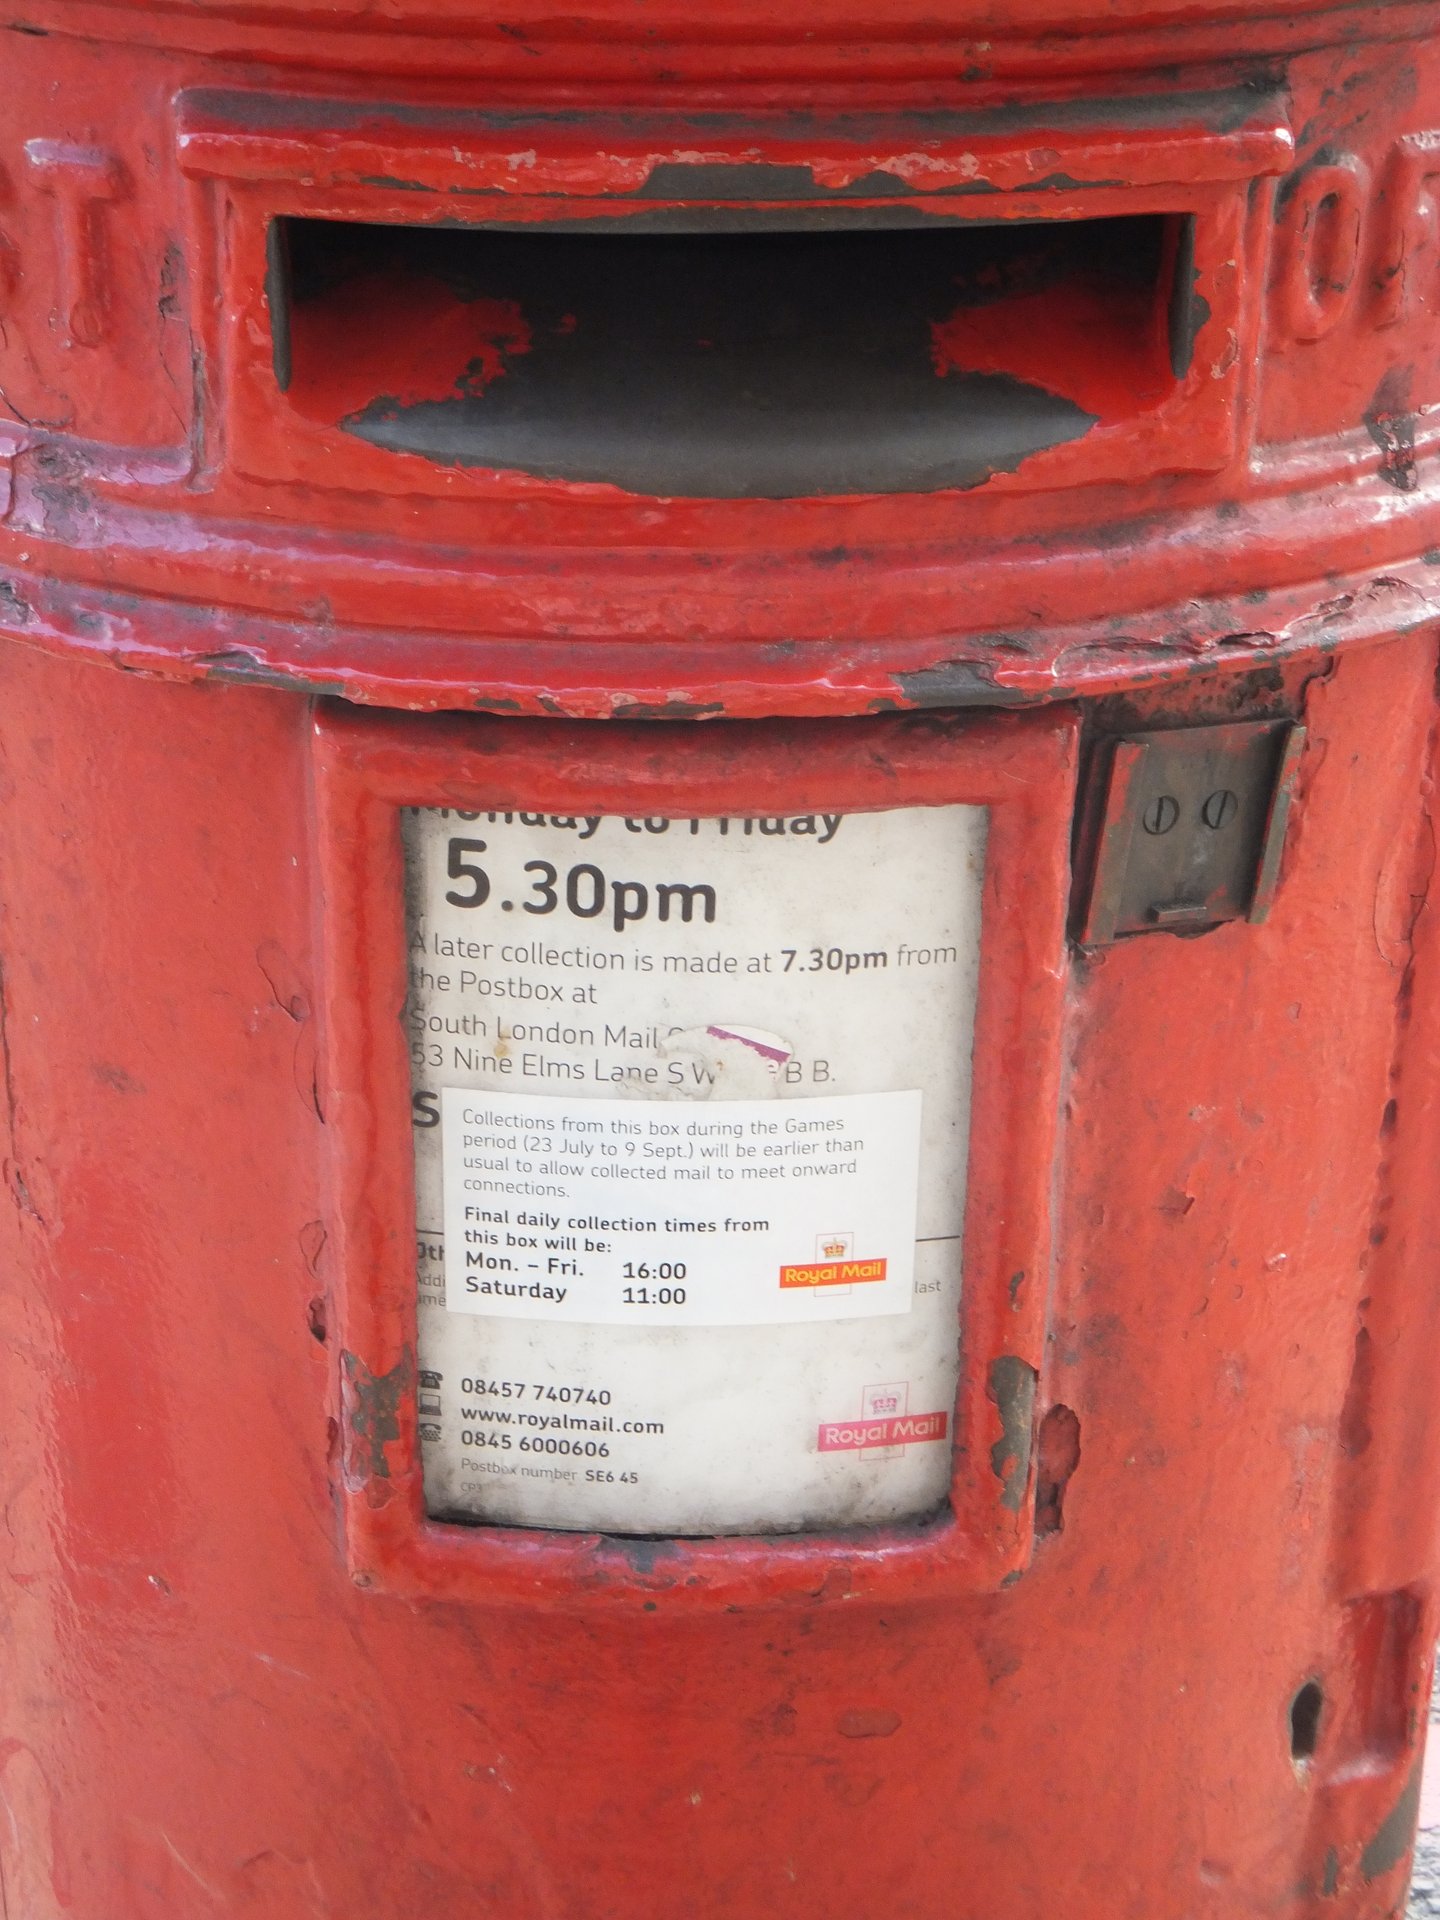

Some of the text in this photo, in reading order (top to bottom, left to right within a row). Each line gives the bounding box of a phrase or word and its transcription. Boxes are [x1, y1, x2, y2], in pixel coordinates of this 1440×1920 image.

[445, 837, 716, 932] 5.30pm
[434, 932, 494, 960] later
[501, 942, 624, 970] collection
[635, 949, 653, 972] is
[664, 951, 738, 974] made
[746, 952, 772, 973] at
[780, 947, 888, 975] 7.30pm
[897, 943, 957, 967] from
[409, 965, 598, 1004] the Postbox at
[410, 1005, 658, 1049] South London Mail
[411, 1042, 443, 1067] 53
[454, 1046, 512, 1074] Nine
[523, 1053, 585, 1080] Elms
[595, 1059, 658, 1084] Lane
[463, 1109, 844, 1138] Collections from this box during the Games
[463, 1133, 864, 1160] period (23 July to 9 Sept.) will be earlier than
[464, 1157, 857, 1180] usual to allow collected mail to meet onward
[464, 1177, 570, 1198] connections.
[465, 1206, 769, 1232] Final daily collection times from
[465, 1230, 612, 1253] this box will be:
[466, 1251, 519, 1272] Mon.
[548, 1258, 584, 1276] Fri.
[622, 1262, 687, 1280] 16:00
[785, 1262, 881, 1284] Royal Mail
[466, 1276, 686, 1305] Saturday 11:00
[914, 1280, 942, 1294] last
[461, 1377, 611, 1405] 08457 740740
[461, 1407, 664, 1434] www.royalmail.com
[826, 1417, 940, 1445] Royal Mail
[461, 1430, 610, 1458] 0845 6000606
[460, 1457, 639, 1483] Postbox number SE6 45
